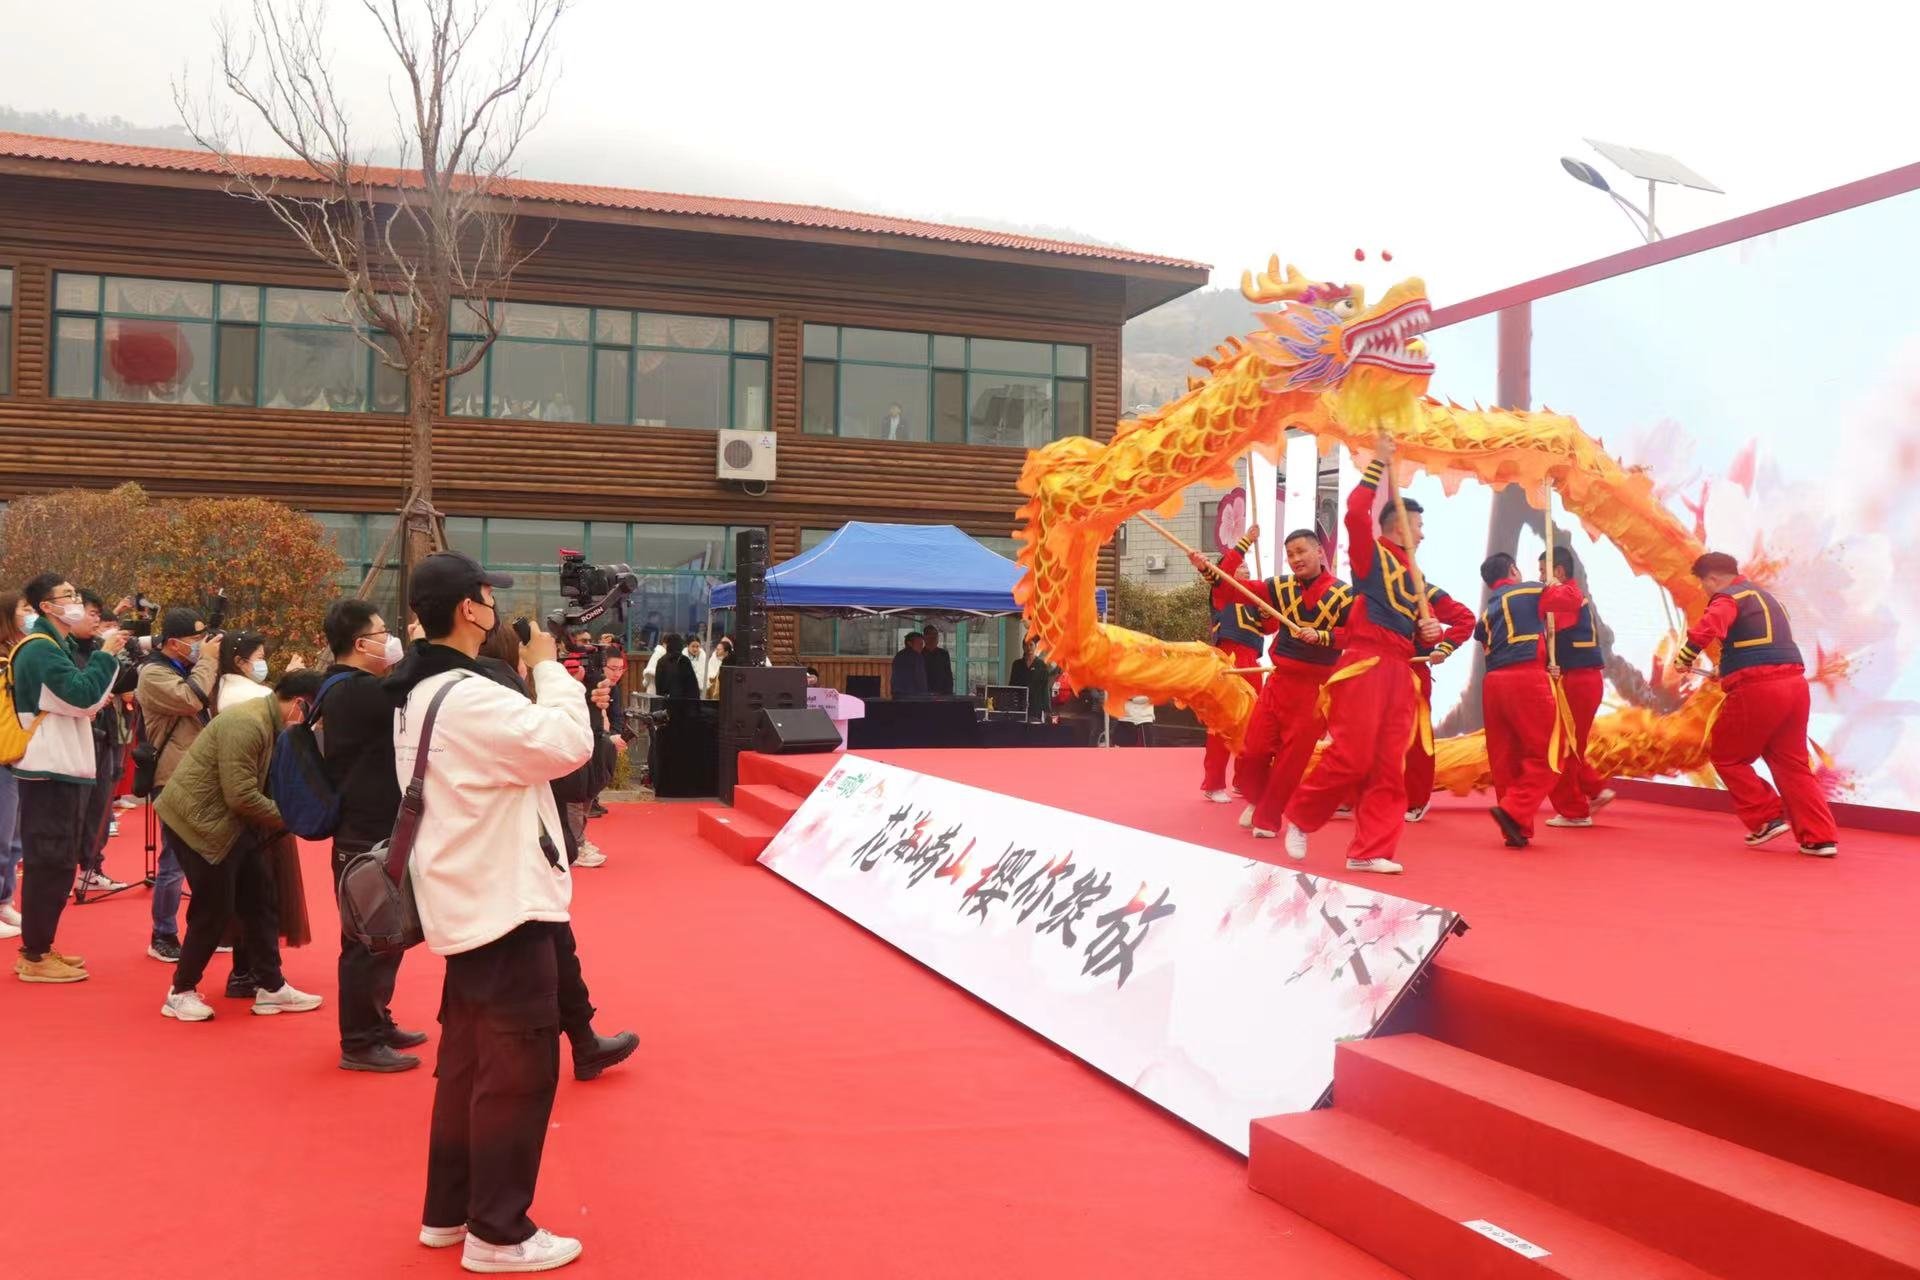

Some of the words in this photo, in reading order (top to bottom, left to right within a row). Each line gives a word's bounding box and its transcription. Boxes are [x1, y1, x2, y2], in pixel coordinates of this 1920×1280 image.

[580, 606, 604, 623] RONIN
[850, 802, 977, 889] 花海崂山
[957, 840, 1177, 990] 樱你绽放
